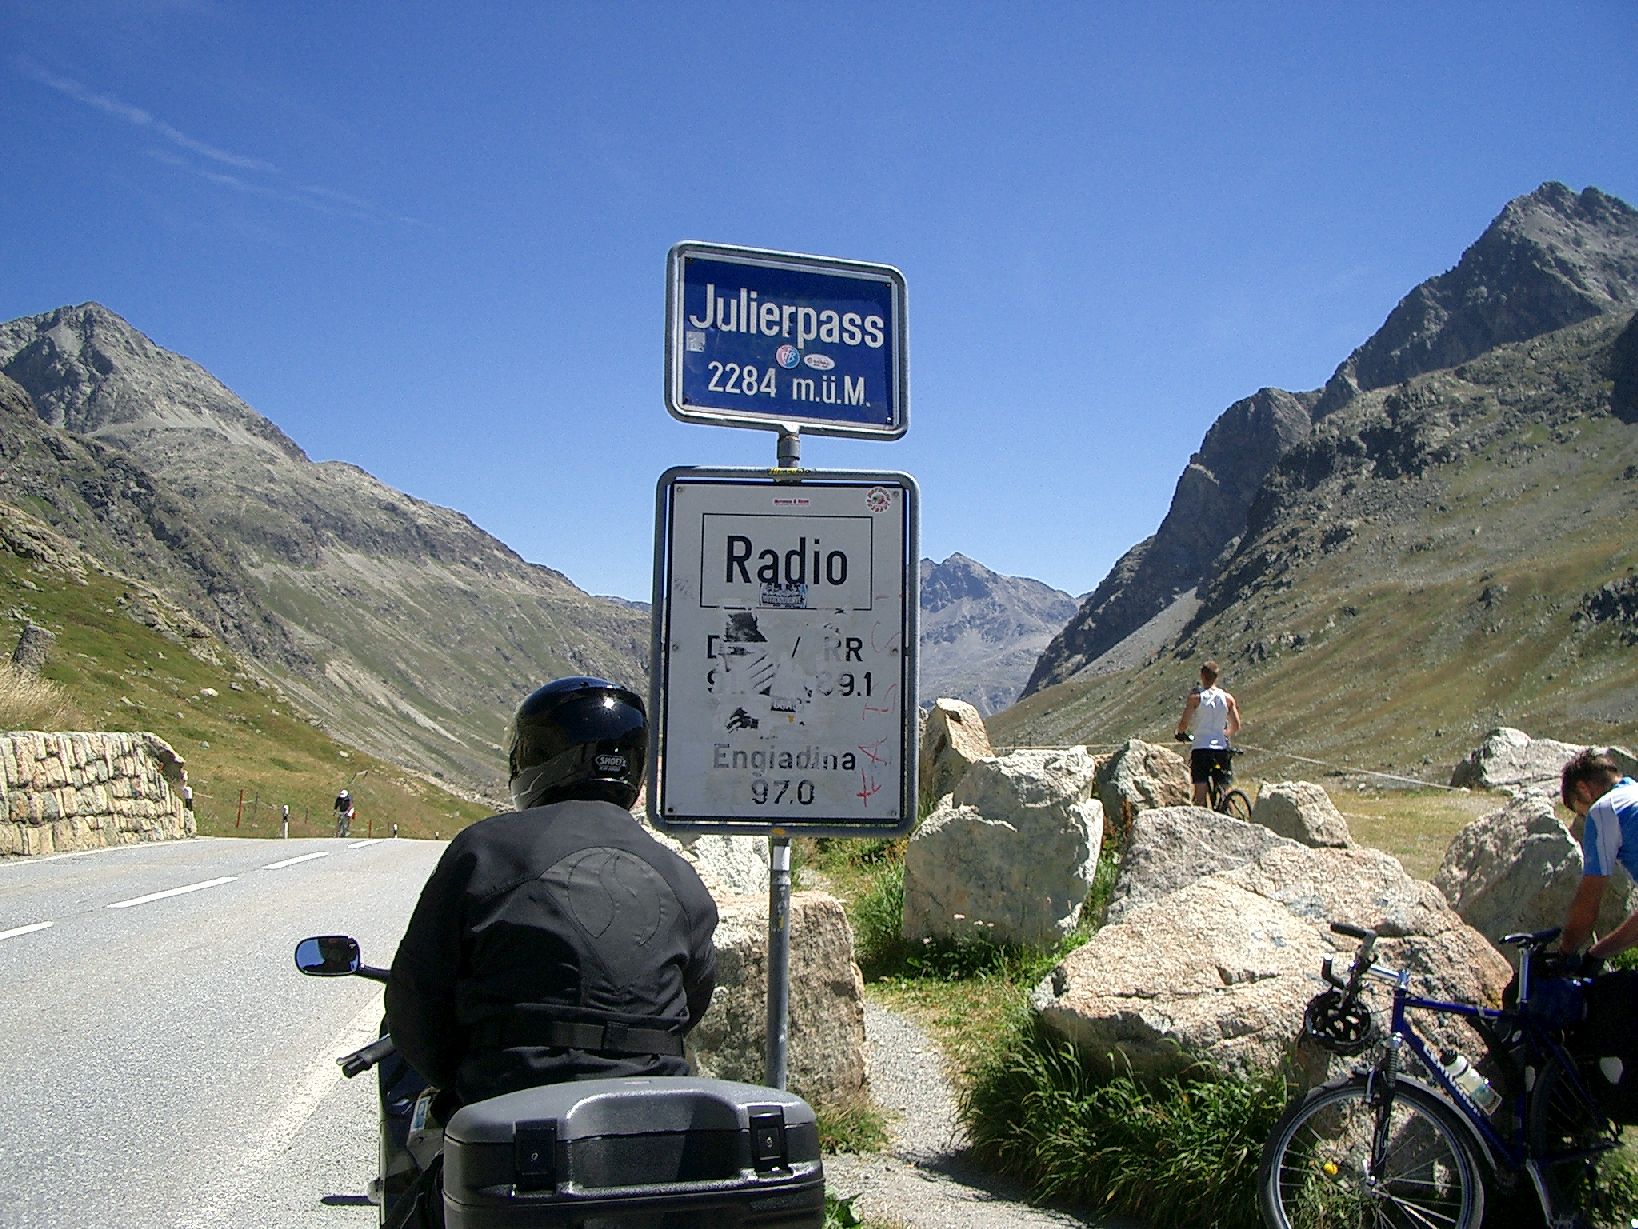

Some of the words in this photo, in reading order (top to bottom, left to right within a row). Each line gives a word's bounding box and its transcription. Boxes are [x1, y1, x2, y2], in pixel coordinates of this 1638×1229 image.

[688, 283, 885, 349] Julierpass
[707, 360, 777, 398] 2284
[791, 375, 872, 408] m.ü.M.
[725, 535, 848, 585] Radio
[713, 743, 856, 777] Engiadina
